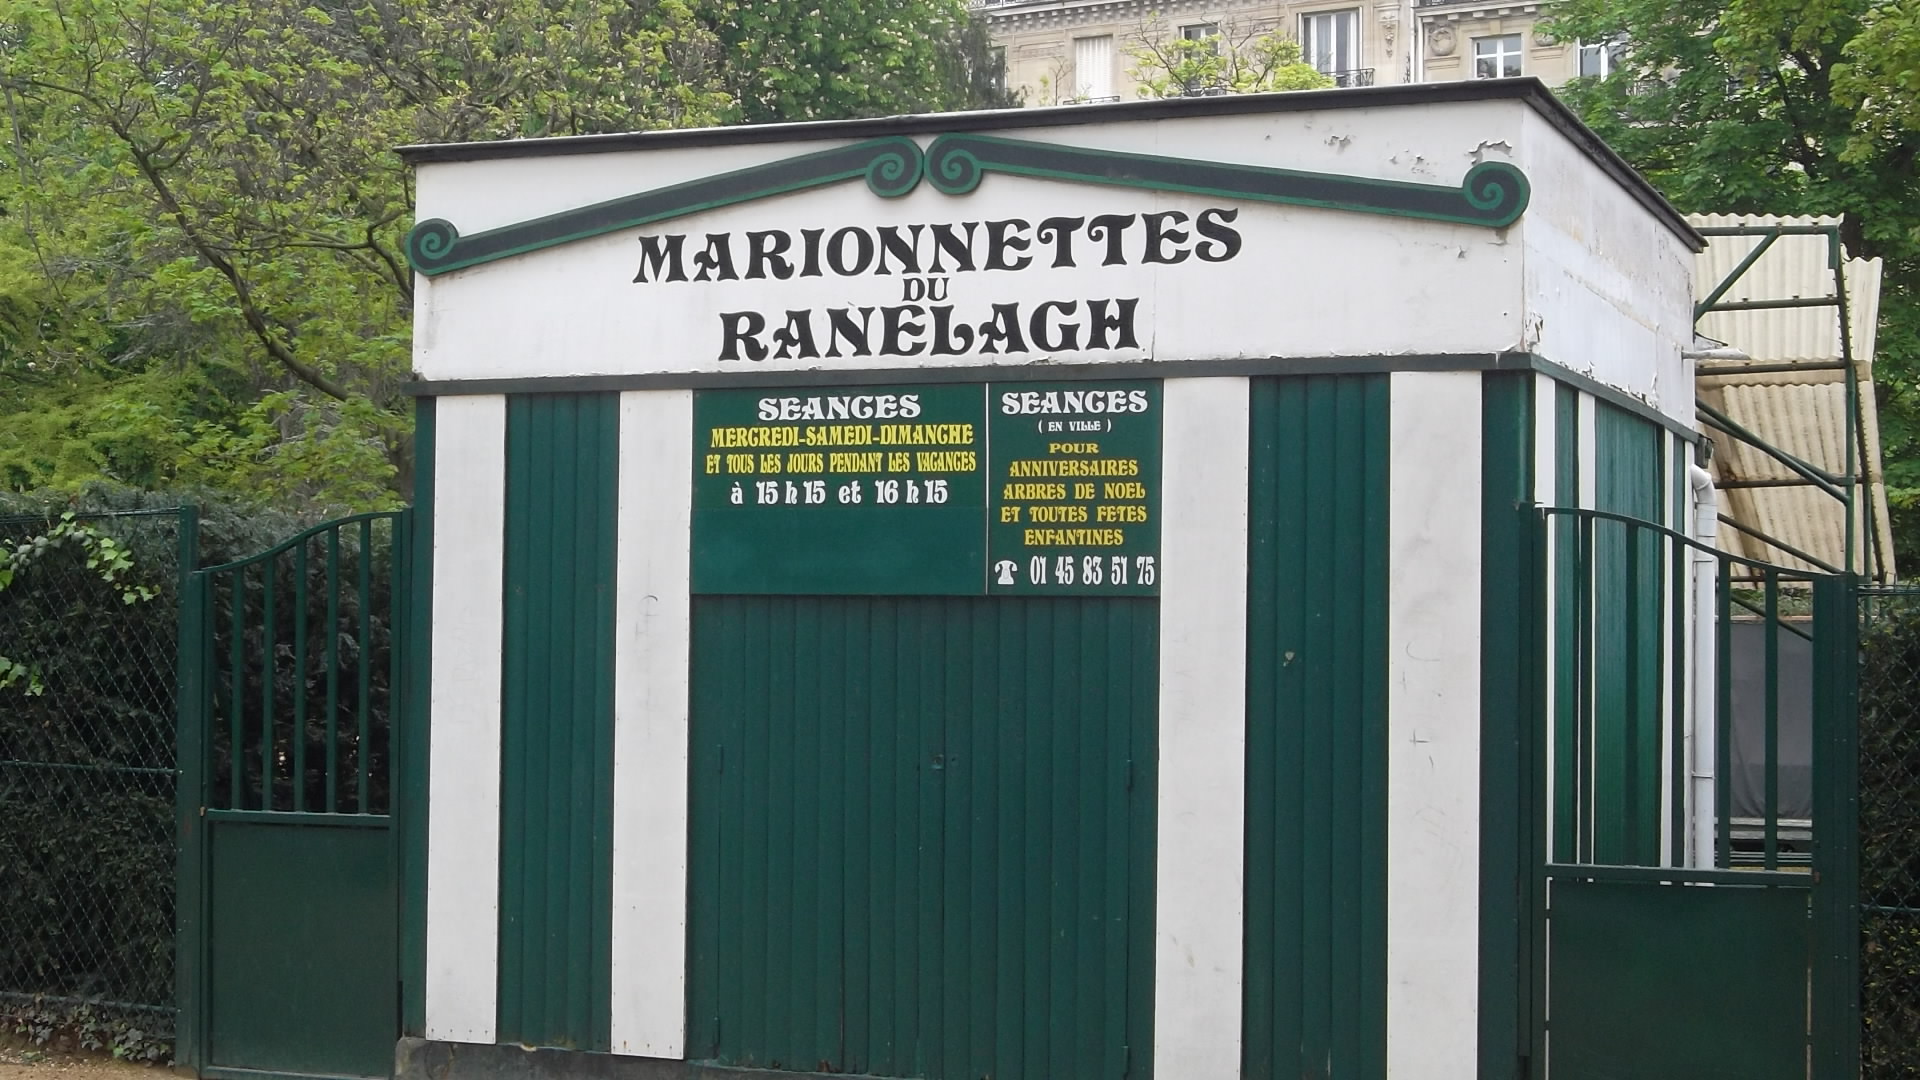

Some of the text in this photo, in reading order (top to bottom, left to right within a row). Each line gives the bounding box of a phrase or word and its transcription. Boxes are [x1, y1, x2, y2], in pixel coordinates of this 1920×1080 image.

[632, 207, 1242, 284] MARIONNETTES
[903, 278, 949, 301] DU
[718, 297, 1140, 362] RANELAGH
[759, 395, 920, 421] SEANCES
[1002, 390, 1148, 414] SEANCES
[1050, 443, 1099, 453] POUR
[706, 451, 976, 474] ET TOUS LES JOURS PENDANT LES VACANCES
[1010, 460, 1138, 476] ANNIVERSAIRES
[731, 480, 947, 504] à 15 h 15 et 16 h 15
[1004, 483, 1145, 499] ARBRES DE NOEL
[1001, 506, 1147, 522] ET TOUTES FETES
[1025, 529, 1123, 545] ENFANTINES
[1030, 556, 1154, 585] 01 45 83 51 75
